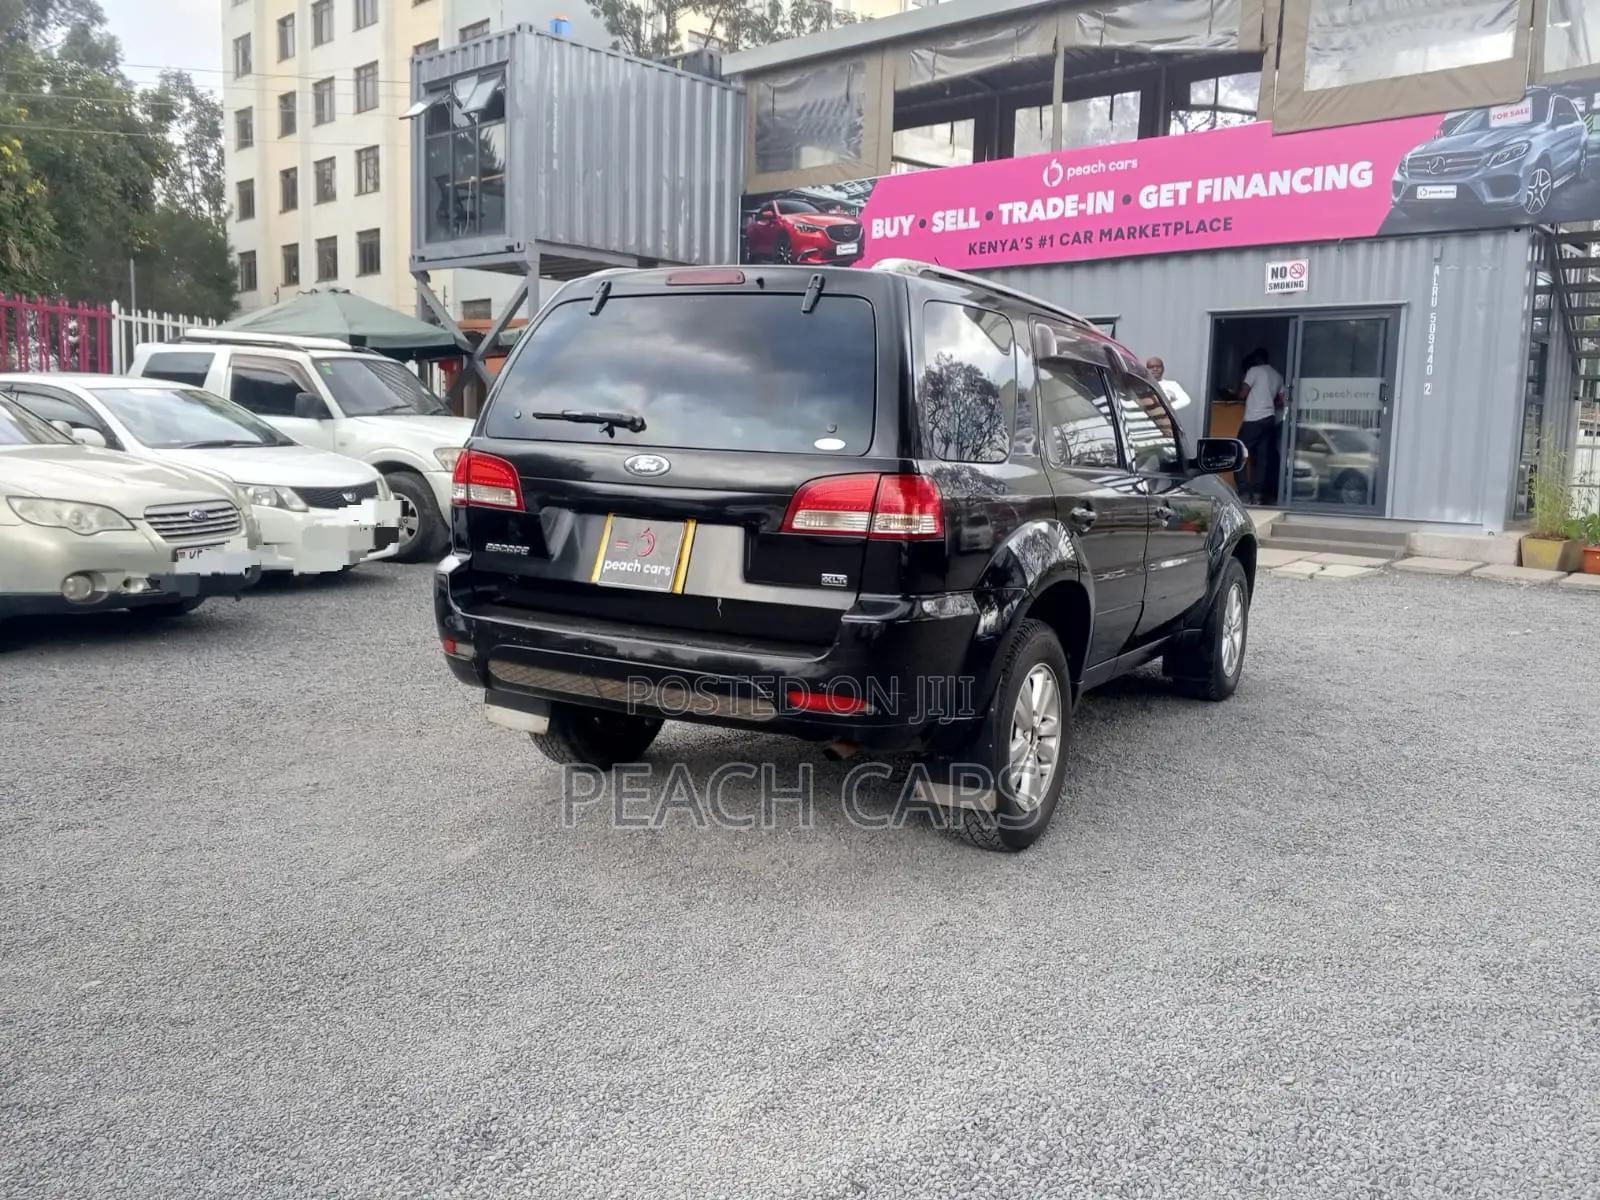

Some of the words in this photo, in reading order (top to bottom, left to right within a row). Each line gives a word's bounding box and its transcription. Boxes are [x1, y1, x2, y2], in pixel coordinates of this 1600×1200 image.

[1491, 112, 1509, 121] FOR
[1510, 106, 1530, 117] SALE
[1067, 160, 1106, 181] peach
[1109, 158, 1138, 172] cars
[871, 214, 915, 239] BUY
[931, 207, 980, 233] SELL
[998, 190, 1115, 225] TRADE-IN
[1138, 181, 1192, 209] GET
[1197, 161, 1373, 204] FINANCING
[968, 236, 1033, 255] KENYA'S
[1038, 234, 1055, 249] #1
[1059, 230, 1094, 246] CAR
[1099, 216, 1233, 243] MARKETPLACE
[1271, 266, 1288, 279] NO
[1268, 280, 1305, 291] SMOKING
[1426, 313, 1436, 375] 509440
[631, 456, 664, 473] Ford
[602, 558, 642, 573] peach
[643, 564, 671, 576] cars
